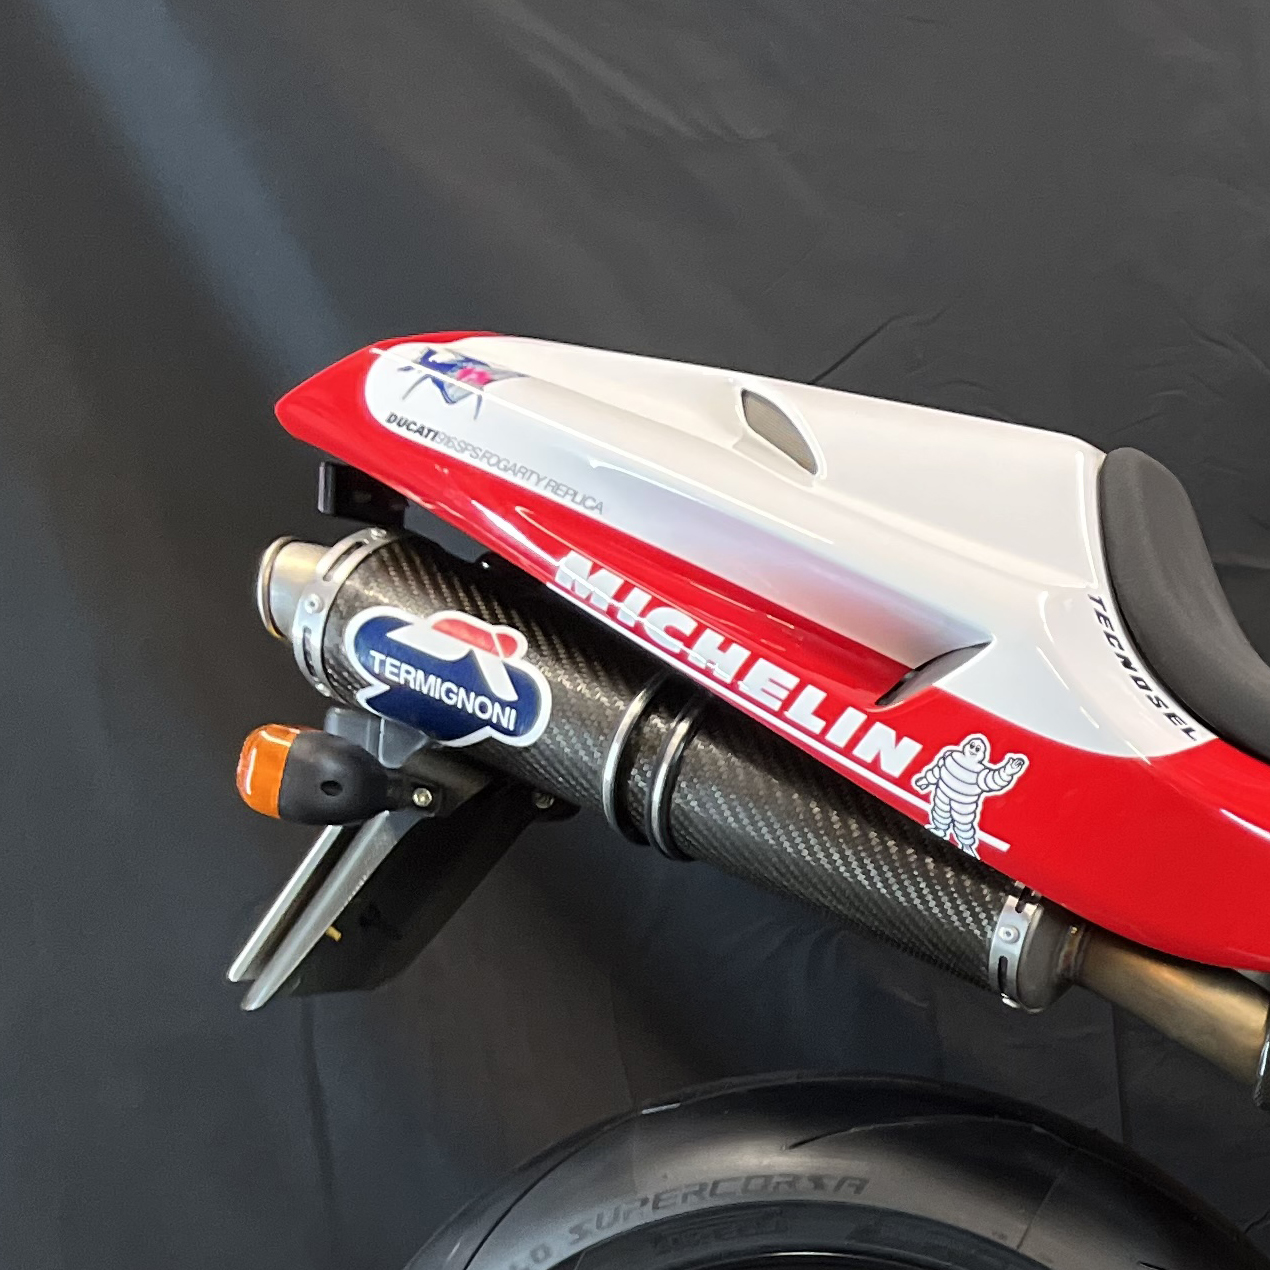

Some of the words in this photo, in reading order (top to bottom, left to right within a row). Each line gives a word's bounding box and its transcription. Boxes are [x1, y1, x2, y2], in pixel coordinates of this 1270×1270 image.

[545, 477, 604, 515] REPLICA
[369, 650, 518, 731] TERMIGNONI
[554, 550, 923, 779] MICHELIN
[1087, 593, 1198, 742] TECNOSEL
